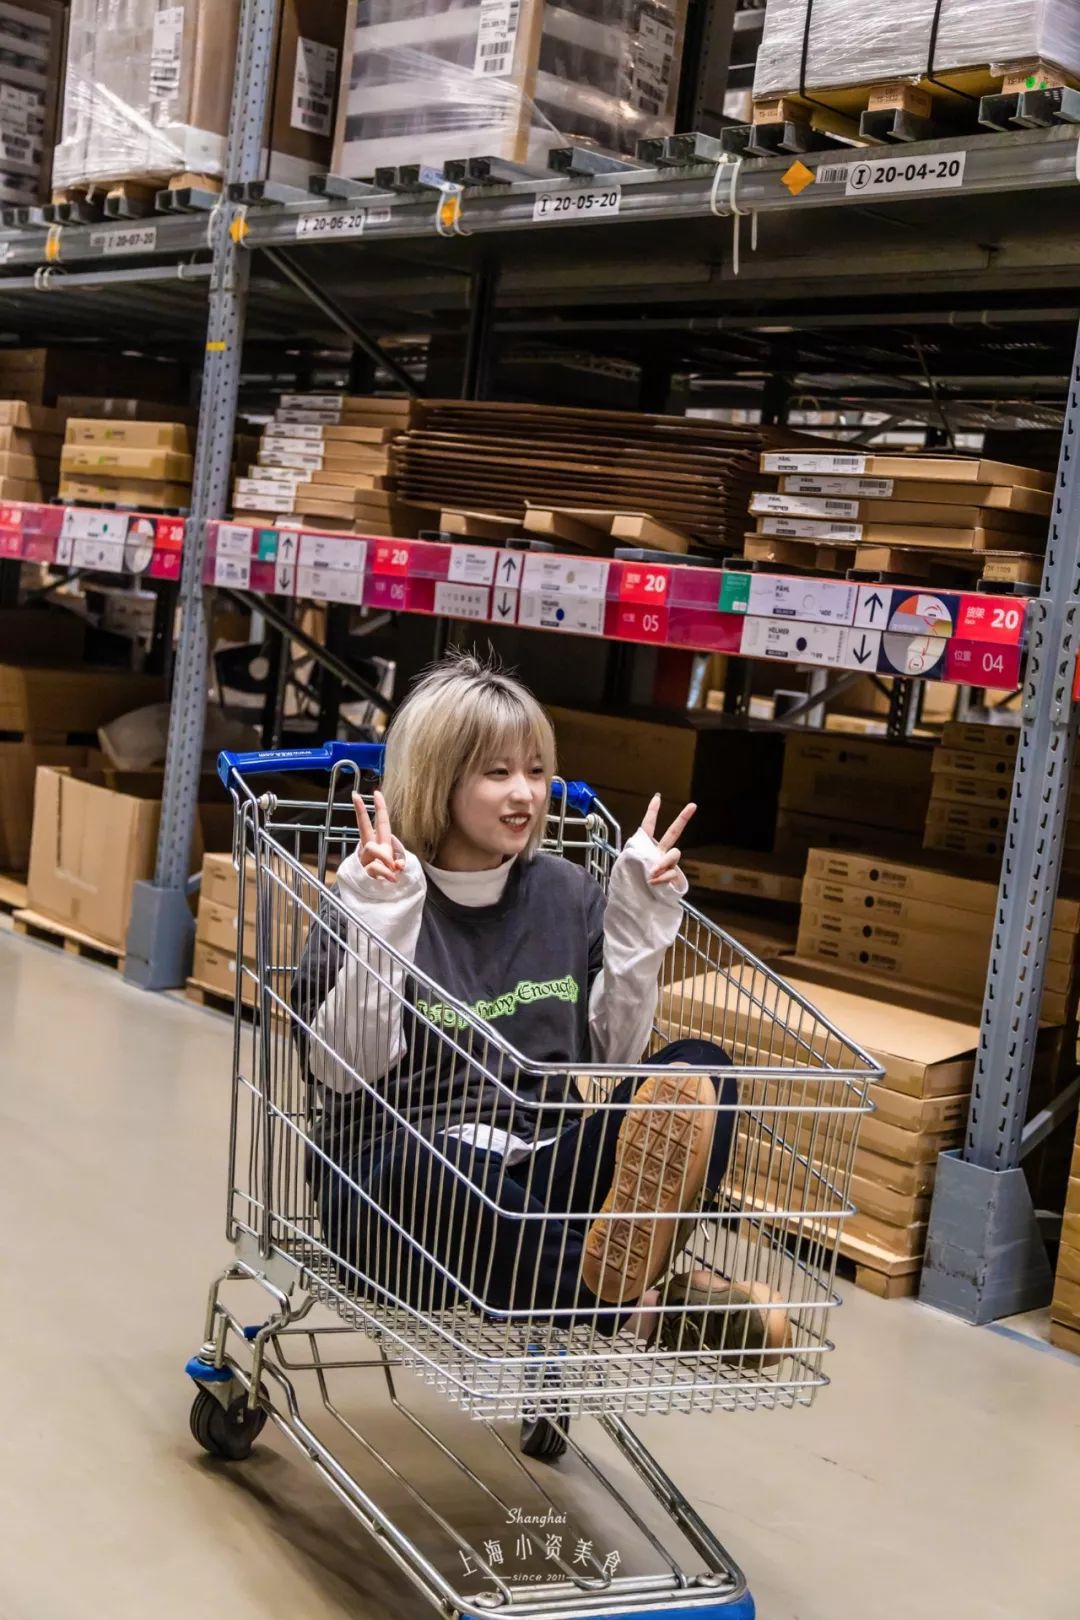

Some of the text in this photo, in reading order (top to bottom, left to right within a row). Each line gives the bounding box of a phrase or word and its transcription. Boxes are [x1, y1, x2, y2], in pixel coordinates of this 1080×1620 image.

[874, 160, 960, 184] 20-04-20
[554, 192, 617, 211] 20-05-20
[313, 215, 362, 231] 20-06-20
[391, 549, 409, 566] 20
[644, 574, 667, 593] 20
[642, 614, 659, 632] 05
[966, 606, 1019, 629] 货架 20
[982, 653, 1004, 673] 04
